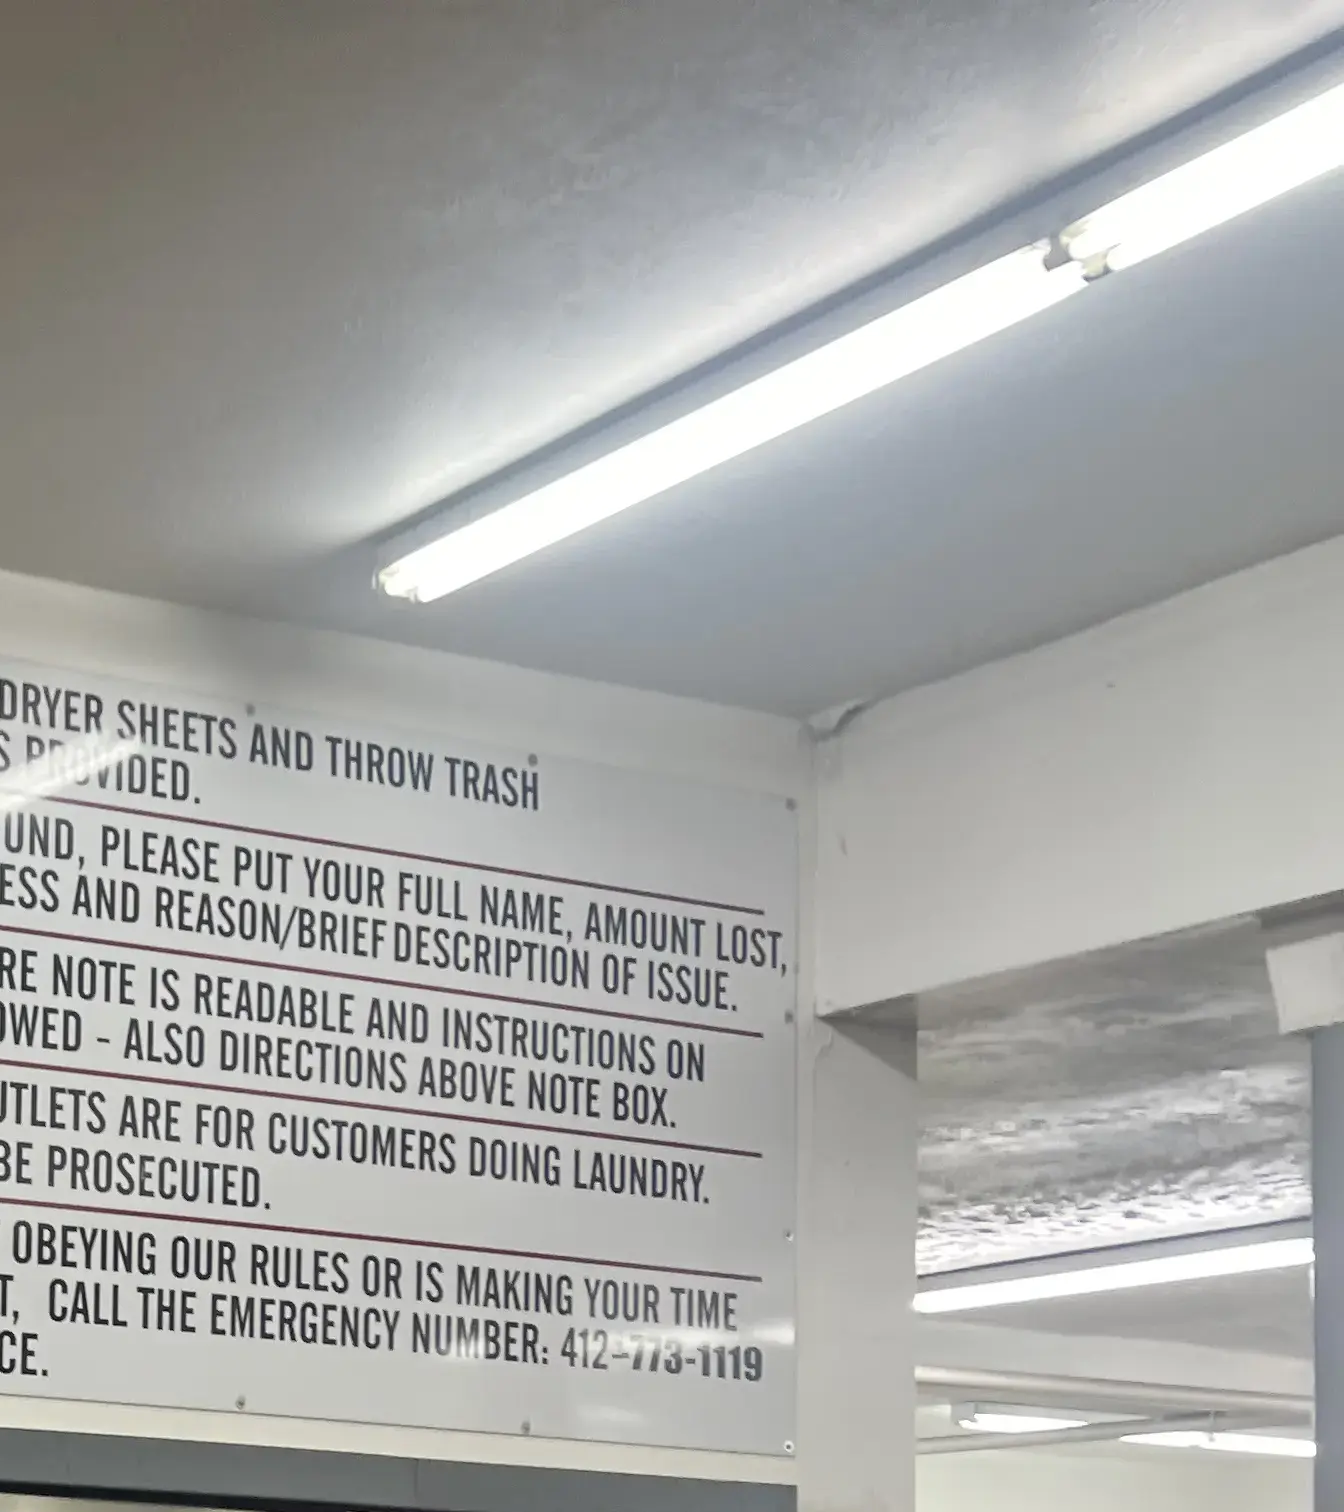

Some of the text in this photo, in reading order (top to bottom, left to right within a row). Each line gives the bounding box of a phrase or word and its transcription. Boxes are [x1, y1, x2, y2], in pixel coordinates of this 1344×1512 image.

[116, 699, 238, 760] SHEETS
[248, 723, 314, 772] AND
[324, 735, 435, 793] THROW
[444, 755, 539, 812] TRASH
[71, 874, 141, 924] AND
[155, 885, 388, 960] REASON/BRIEF
[393, 921, 590, 990] DESCRIPTION
[601, 953, 638, 996] OF
[647, 959, 738, 1012] ISSUE.
[101, 824, 220, 884] PLEASE
[233, 844, 294, 895] PUT
[302, 855, 385, 909] YOUR
[398, 871, 469, 922] FULL
[479, 884, 573, 945] NAME,
[583, 901, 707, 958] AMOUNT
[716, 921, 787, 978] LOST,
[52, 952, 136, 1007] NOTE
[149, 966, 181, 1013] IS
[193, 972, 356, 1035] READABLE
[365, 996, 429, 1044] AND
[442, 1006, 656, 1077] INSTRUCTIONS
[666, 1038, 705, 1083] ON
[123, 1017, 206, 1069] ALSO
[219, 1029, 408, 1094] DIRECTIONS
[417, 1055, 516, 1108] ABOVE
[527, 1069, 601, 1119] NOTE
[612, 1080, 677, 1129] BOX.
[47, 1144, 272, 1211] PROSECUTED.
[118, 1094, 182, 1144] ARE
[195, 1103, 255, 1152] FOR
[267, 1111, 457, 1175] CUSTOMERS
[468, 1135, 561, 1187] DOING
[573, 1148, 710, 1205] LAUNDRY.
[11, 1219, 157, 1276] OBEYING
[170, 1235, 237, 1284] OUR
[250, 1243, 350, 1295] RULES
[361, 1254, 403, 1300] OR
[415, 1259, 445, 1304] IS
[455, 1263, 574, 1316] MAKING
[583, 1277, 660, 1324] YOUR
[669, 1286, 738, 1332] TIME
[47, 1277, 128, 1328] CALL
[136, 1286, 198, 1334] THE
[210, 1292, 401, 1352] EMERGENCY
[411, 1311, 549, 1365] NUMBER:
[560, 1327, 763, 1382] 412-773-1119
